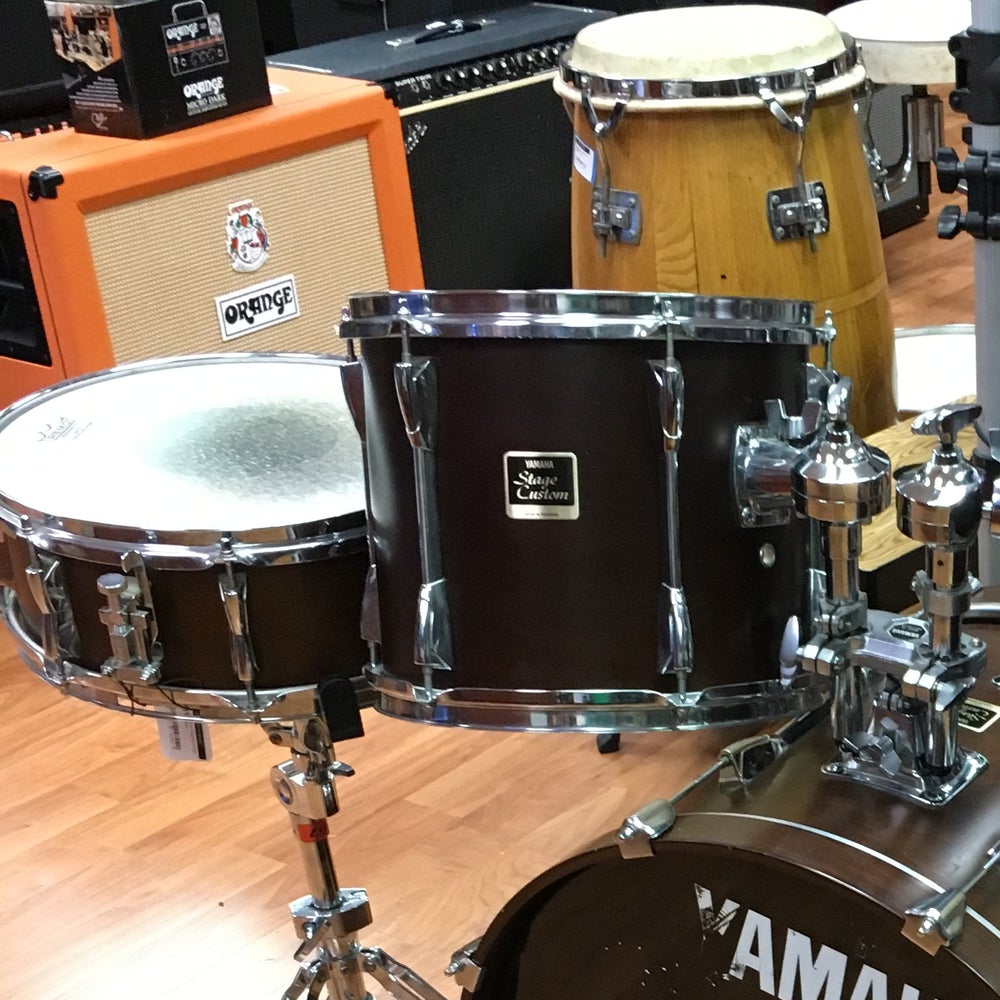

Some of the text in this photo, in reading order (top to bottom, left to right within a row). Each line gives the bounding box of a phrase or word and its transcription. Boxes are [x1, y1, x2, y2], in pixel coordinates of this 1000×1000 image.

[183, 76, 224, 99] ORANGE
[225, 286, 293, 325] ORANGE
[524, 459, 555, 469] YAMAHA
[513, 470, 558, 489] Stage
[516, 484, 569, 500] Custom
